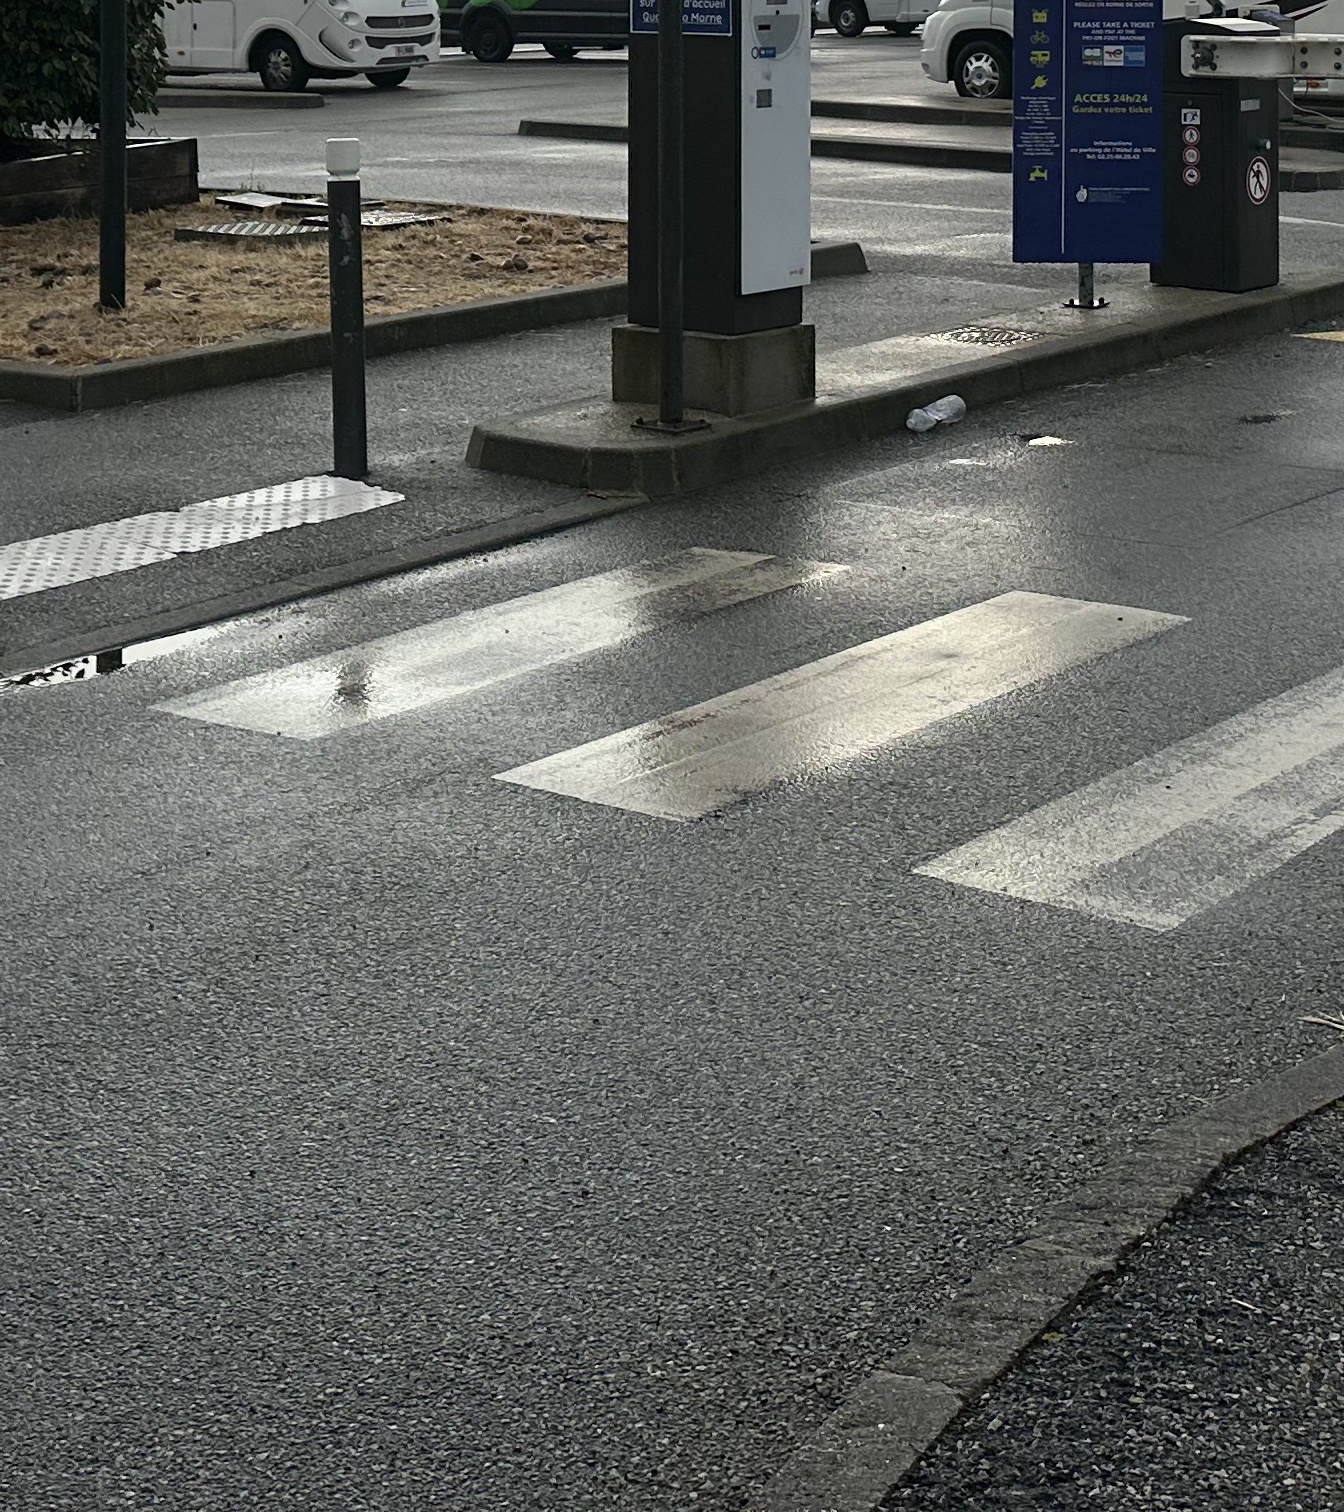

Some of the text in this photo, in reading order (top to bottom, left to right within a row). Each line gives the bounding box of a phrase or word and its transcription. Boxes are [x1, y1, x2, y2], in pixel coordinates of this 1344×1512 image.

[1073, 93, 1149, 103] ACCES 24h/24
[1072, 105, 1154, 114] Gardez votre ticket
